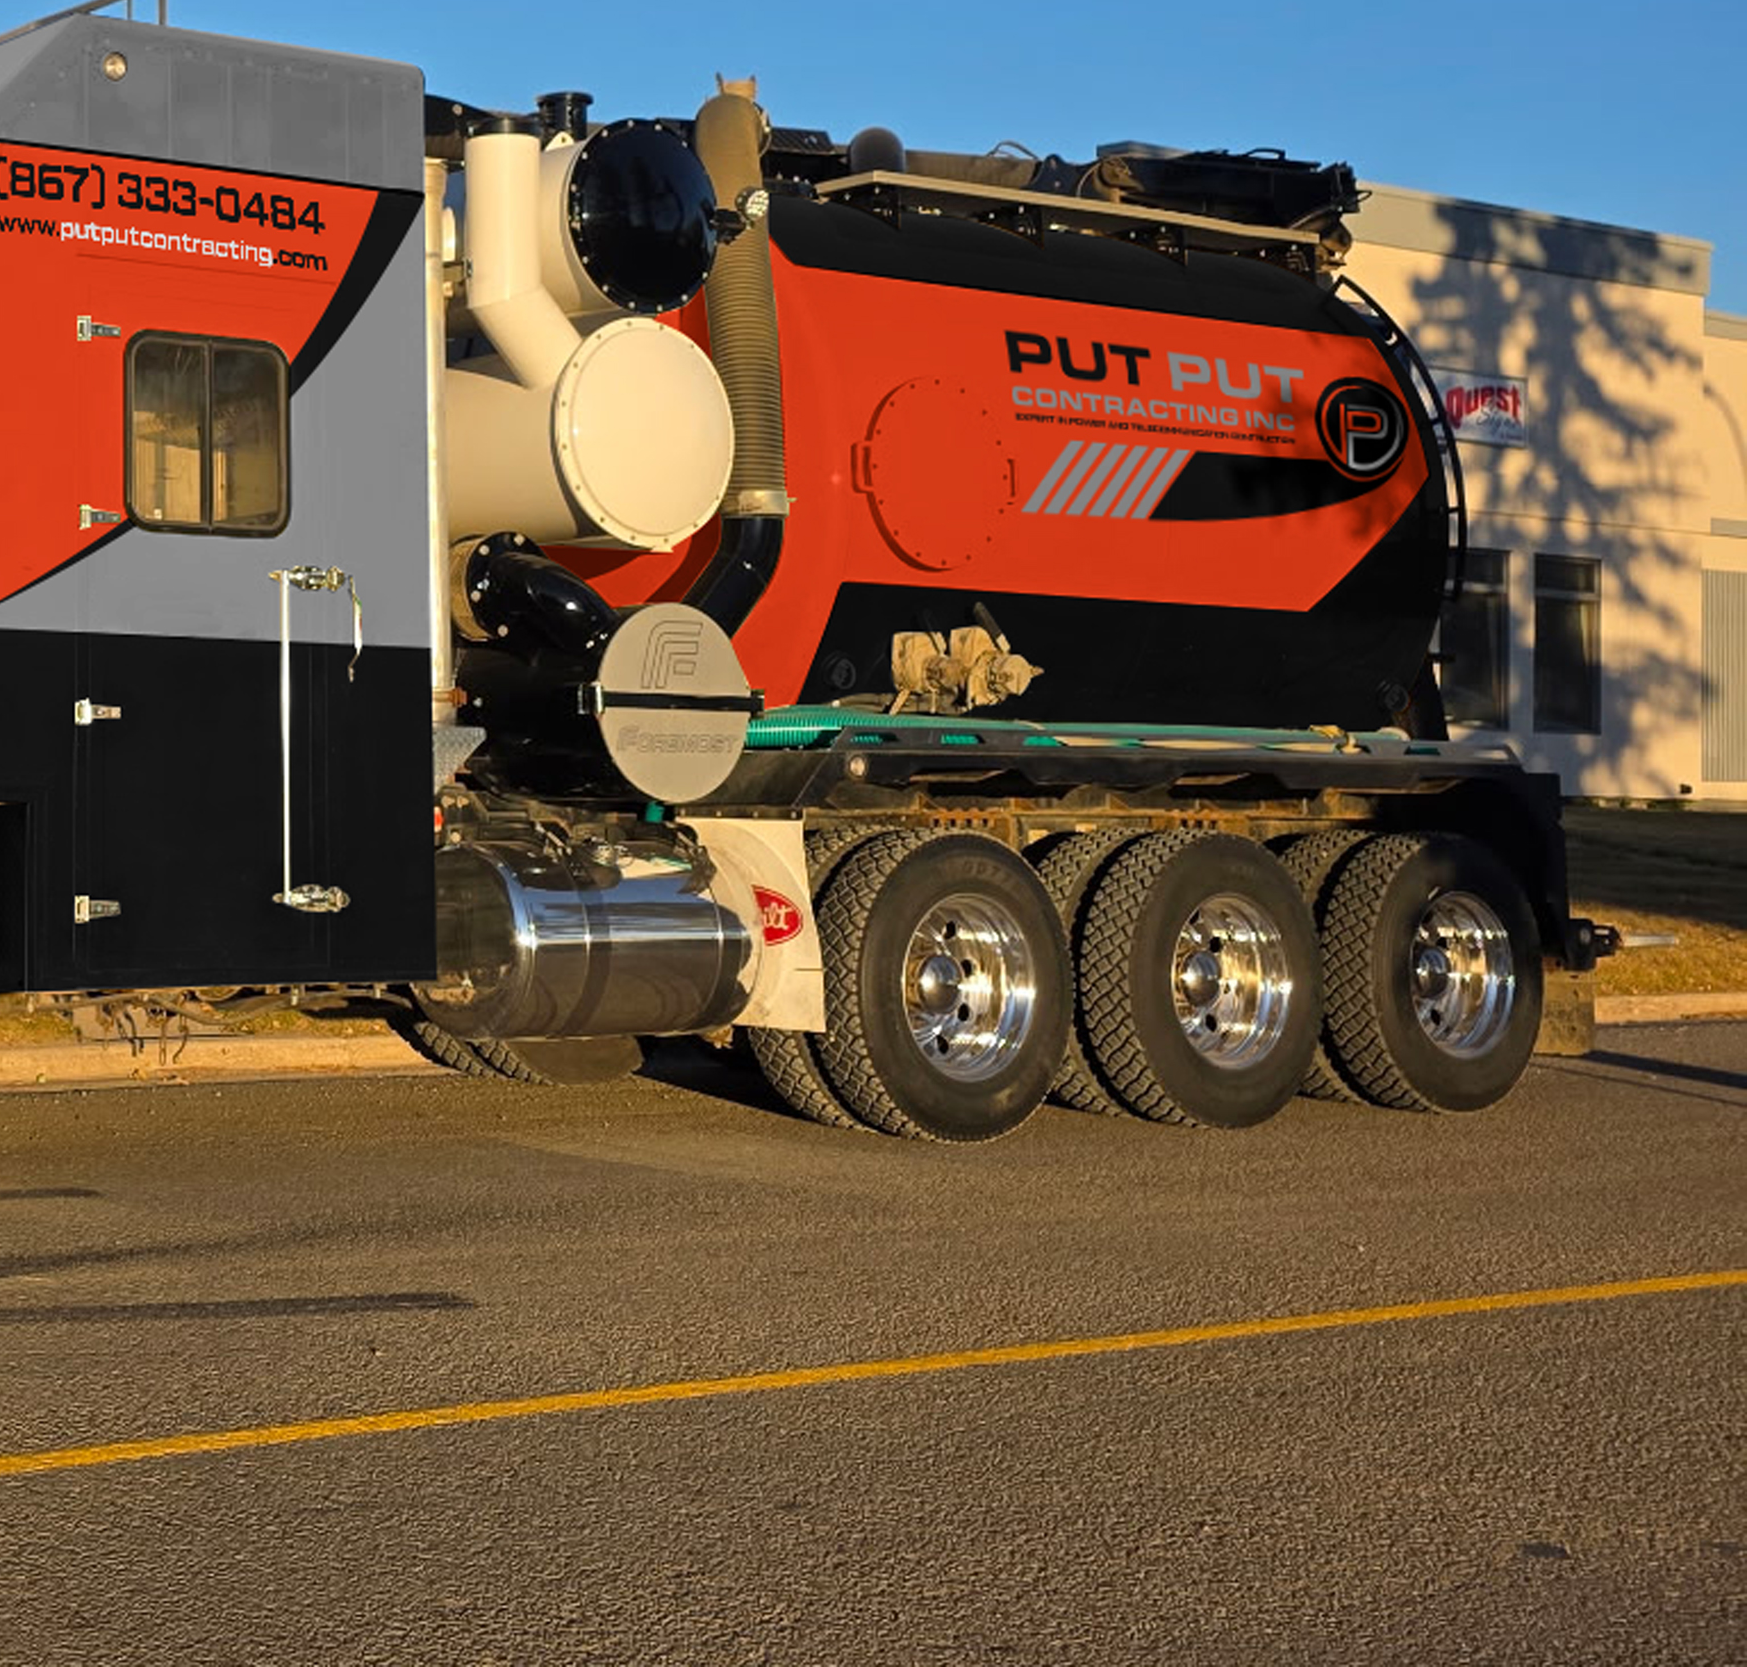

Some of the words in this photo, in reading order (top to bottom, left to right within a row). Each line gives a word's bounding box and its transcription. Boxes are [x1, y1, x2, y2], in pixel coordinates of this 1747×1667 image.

[117, 173, 326, 235] 333-0484
[1005, 330, 1151, 386] PUT
[1167, 351, 1304, 403] PUT
[1012, 386, 1238, 426] CONTRACTING
[1246, 410, 1295, 431] INC
